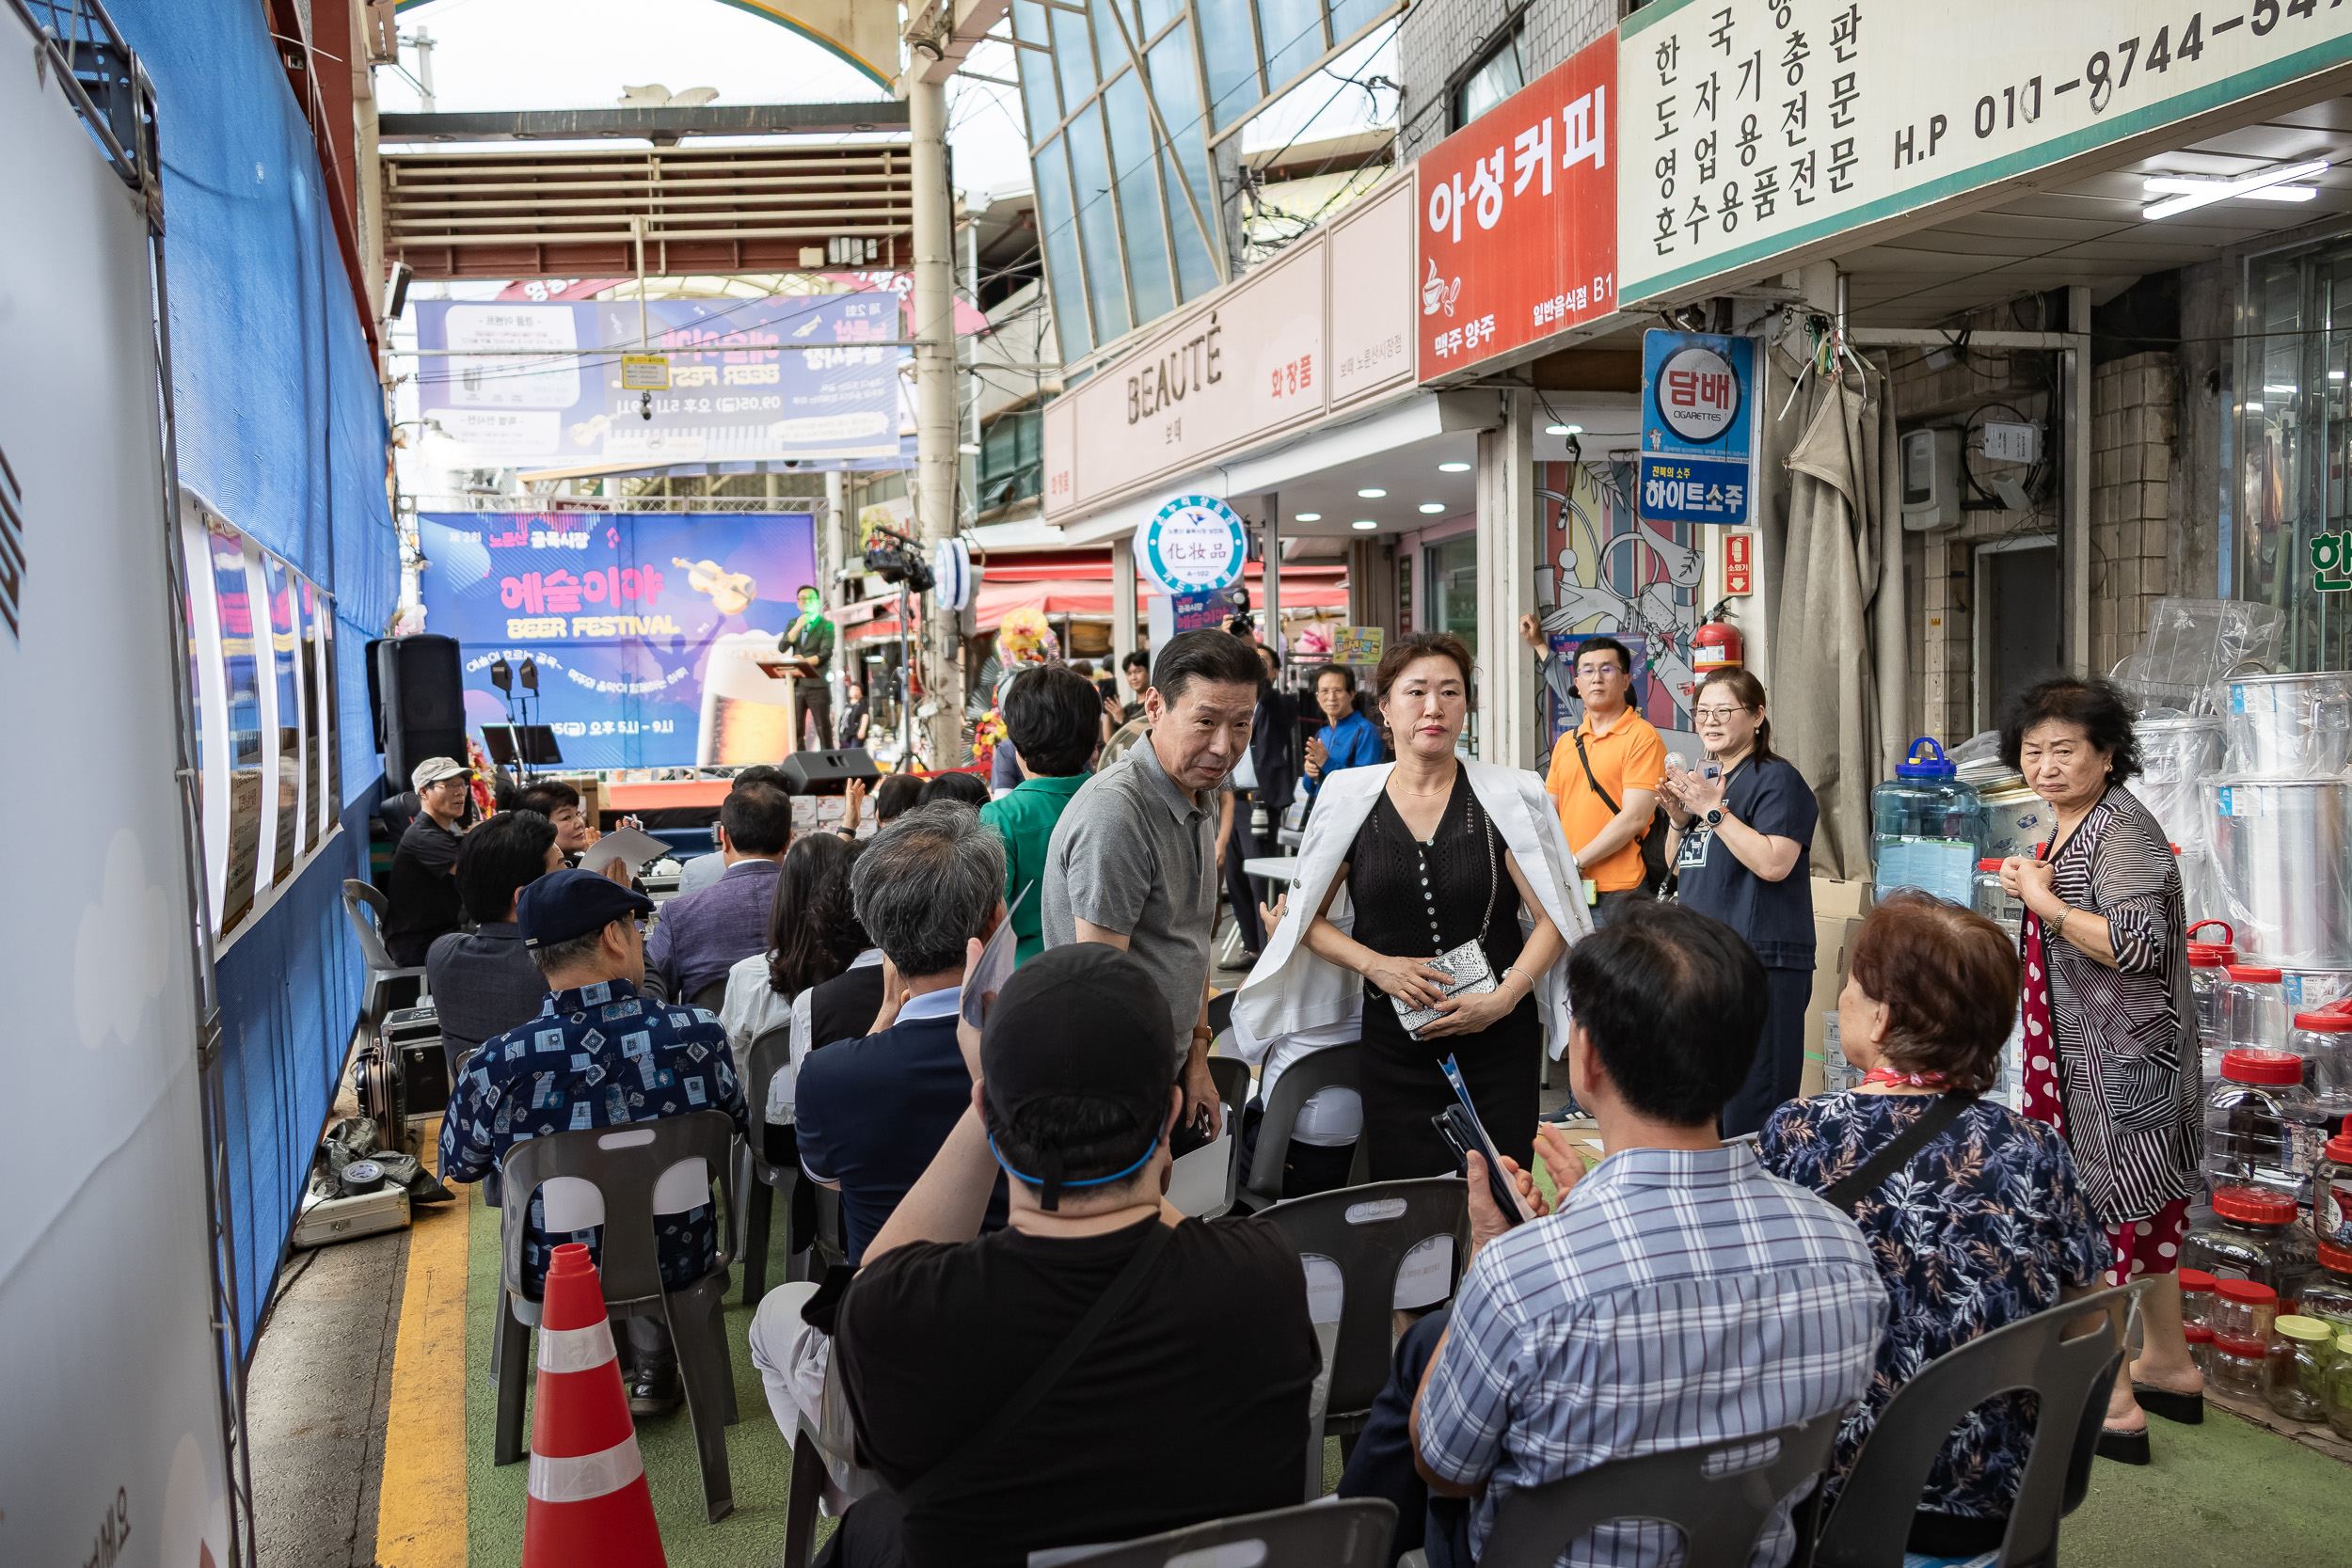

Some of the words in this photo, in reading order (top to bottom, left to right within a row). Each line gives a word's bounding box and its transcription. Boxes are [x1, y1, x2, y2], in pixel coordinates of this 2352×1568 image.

[1654, 2, 1863, 142] 도자기총판
[1654, 71, 1861, 200] 영업용전문
[1894, 114, 1947, 170] H.P
[1428, 84, 1606, 244] 아성커피
[1653, 136, 1859, 257] 혼수용품전문
[1533, 285, 1588, 327] 일반음식점
[1593, 272, 1613, 303] B1
[1435, 327, 1463, 358] 맥주
[1465, 314, 1496, 350] 양주
[1127, 310, 1222, 425] BEAUTÉ
[1272, 354, 1311, 399] 화장품
[1668, 370, 1730, 410] 담배
[1673, 410, 1722, 421] CIGARETTES
[1676, 467, 1691, 479] 소주
[1645, 479, 1743, 514] 하이트소주
[500, 563, 665, 615] 예술이야
[1727, 563, 1749, 572] 소화기
[506, 617, 567, 640] BEER
[572, 613, 681, 639] FESTIVAL
[589, 721, 616, 736] 오후
